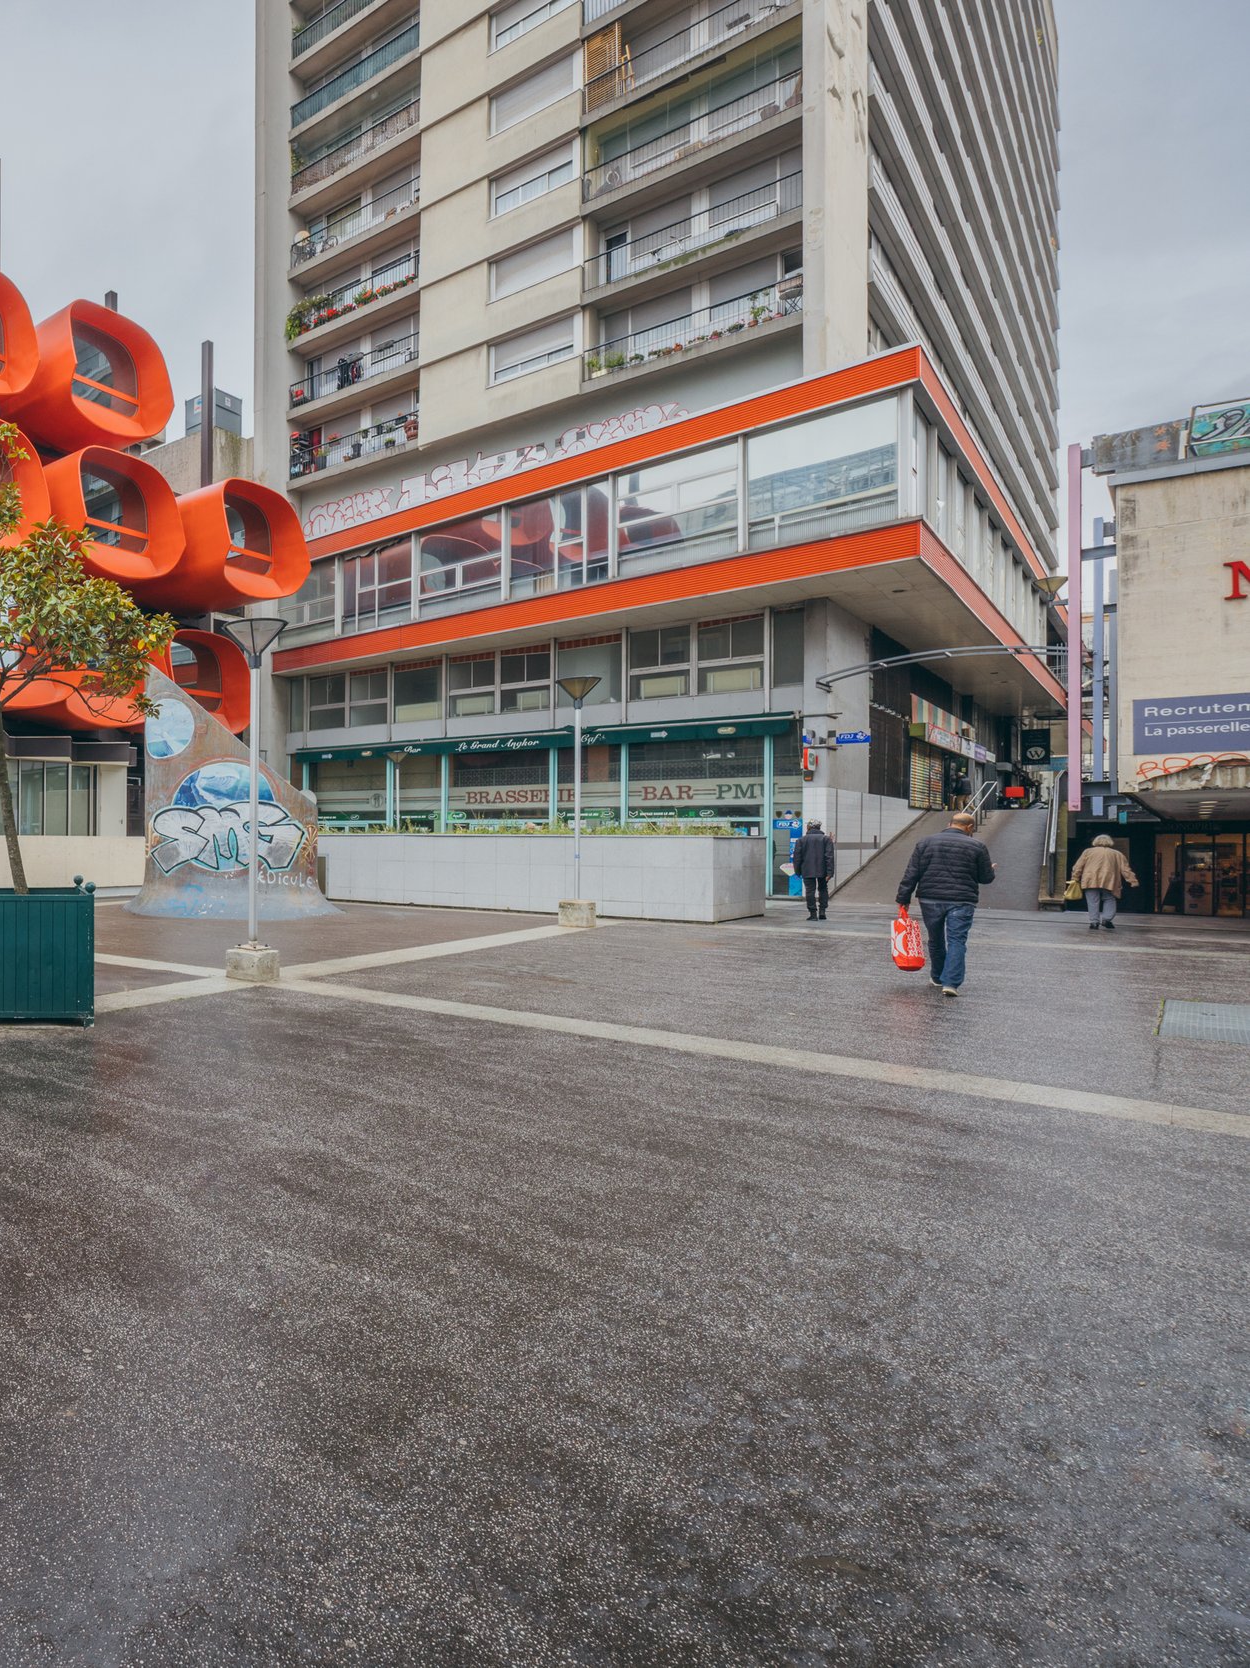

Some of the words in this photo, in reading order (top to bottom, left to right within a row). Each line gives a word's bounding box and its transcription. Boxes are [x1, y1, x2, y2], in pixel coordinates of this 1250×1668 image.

[1144, 726, 1163, 737] La
[1167, 721, 1250, 738] passerelle
[455, 741, 468, 752] Le
[470, 738, 501, 750] Grand
[501, 737, 540, 751] Angkor
[642, 784, 694, 801] BAR
